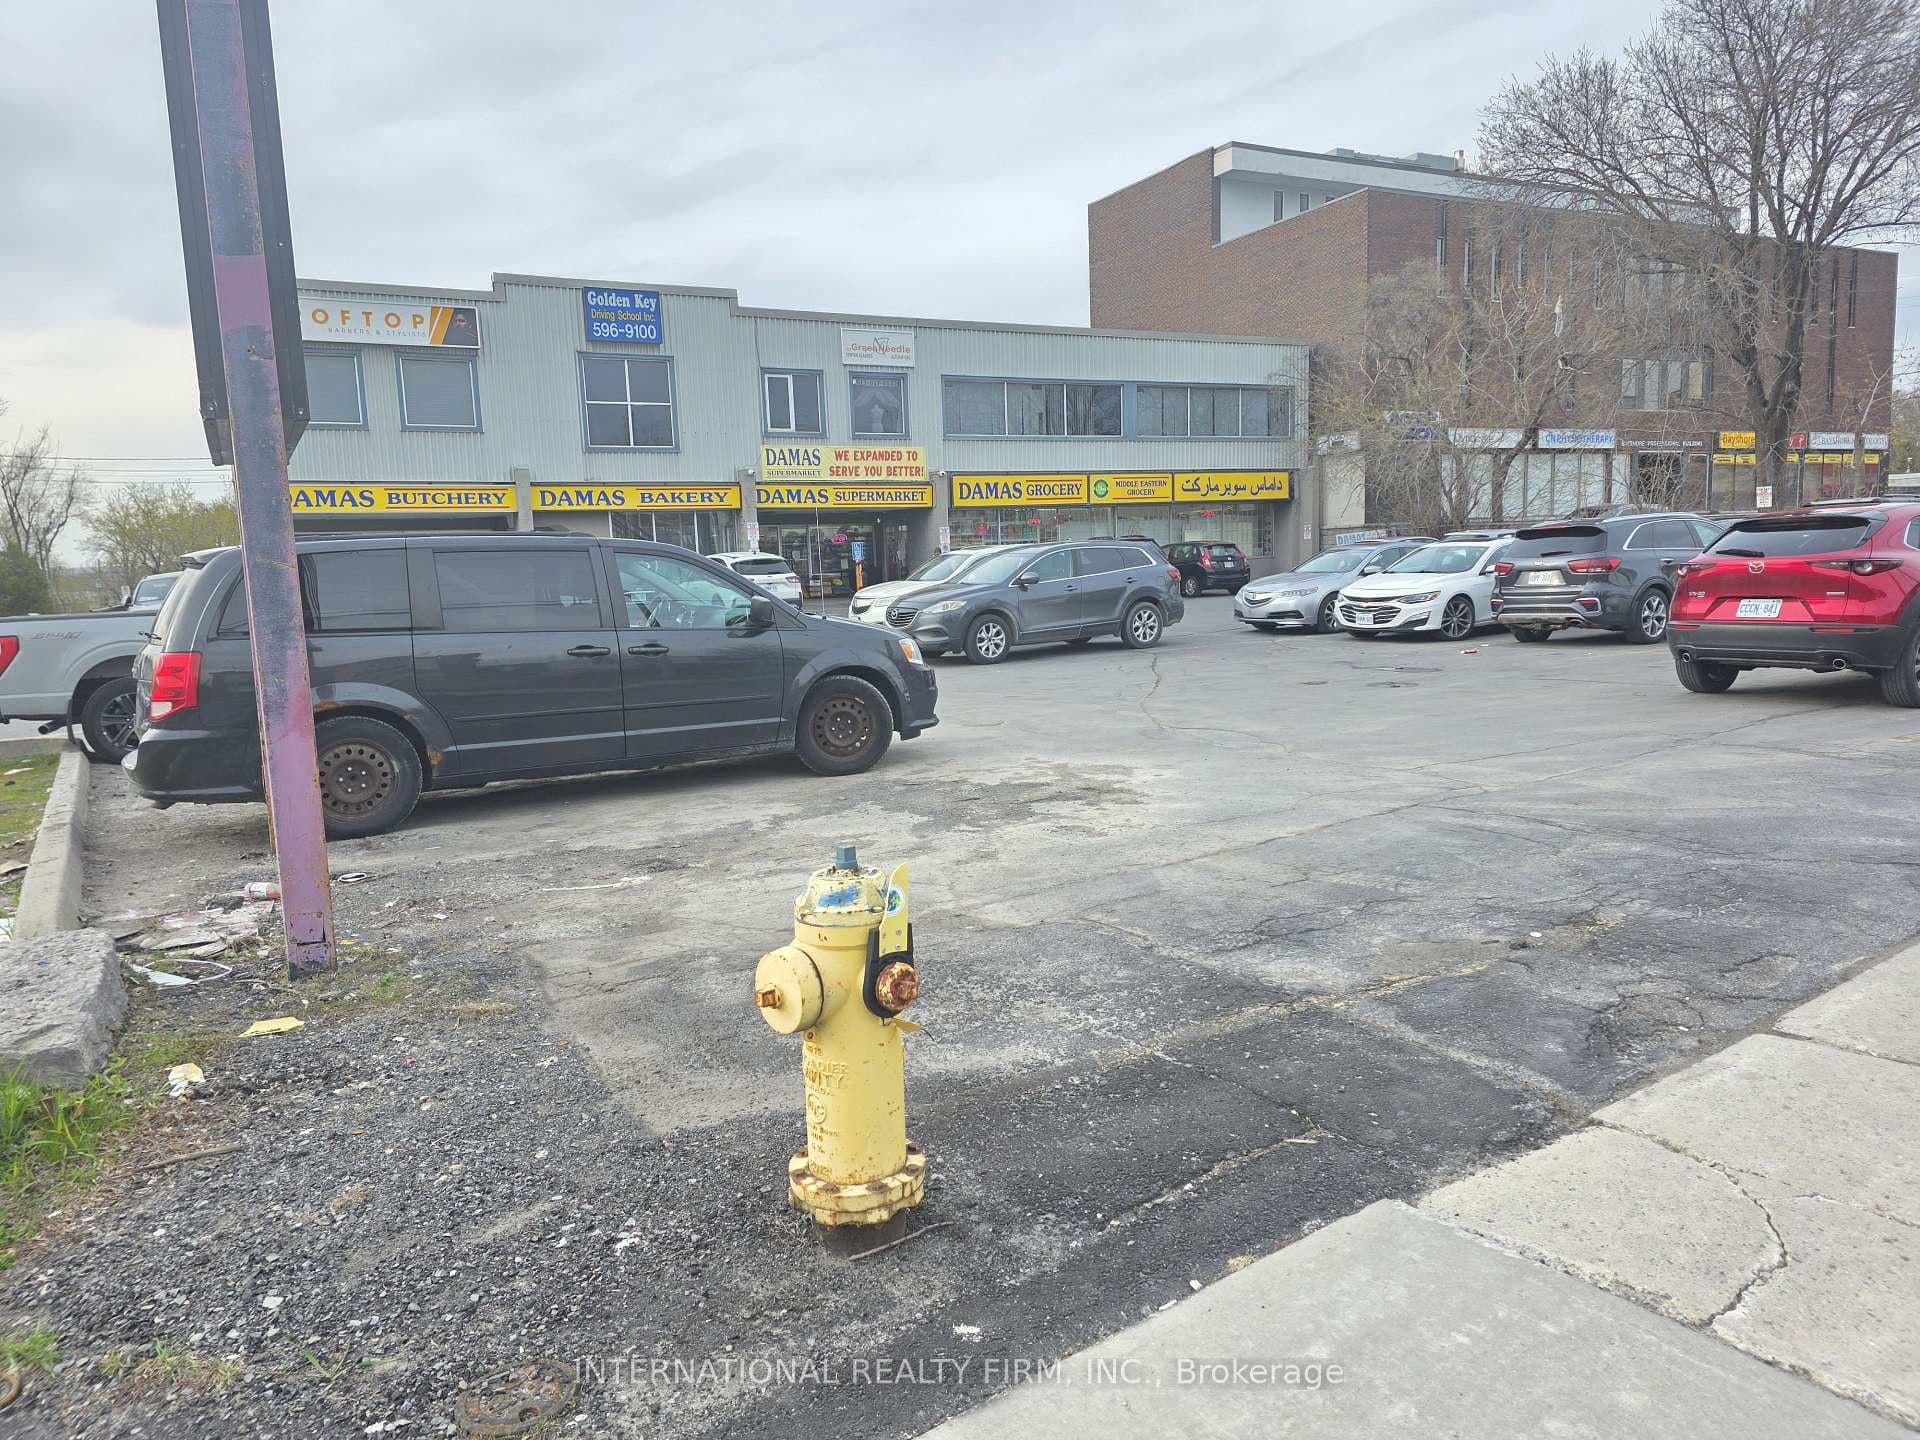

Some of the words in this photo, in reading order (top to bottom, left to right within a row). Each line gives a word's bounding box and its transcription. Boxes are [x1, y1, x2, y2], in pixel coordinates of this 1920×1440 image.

[587, 291, 630, 308] Golden
[634, 294, 657, 312] Key
[591, 309, 615, 321] Driving
[618, 310, 641, 321] School
[644, 312, 656, 321] Inc.
[592, 322, 657, 339] 596-9100
[765, 448, 821, 466] DAMAS
[834, 450, 849, 461] WE
[853, 450, 903, 461] EXPANDED
[906, 450, 918, 461] TO
[767, 469, 822, 477] SUPERMARKET
[829, 466, 860, 477] SERVE
[864, 466, 882, 477] YOU
[886, 466, 924, 477] BETTER!
[958, 482, 1023, 500] DAMAS
[1026, 484, 1082, 496] GROCERY
[1115, 480, 1139, 488] MIDDLE
[289, 490, 376, 507] AMAS
[387, 492, 507, 504] BUTCHERY
[539, 490, 626, 507] DAMAS
[639, 491, 729, 504] BAKERY
[756, 489, 829, 504] DAMAS
[834, 490, 927, 502] SUPERMARKET
[1126, 488, 1156, 496] GROCERY
